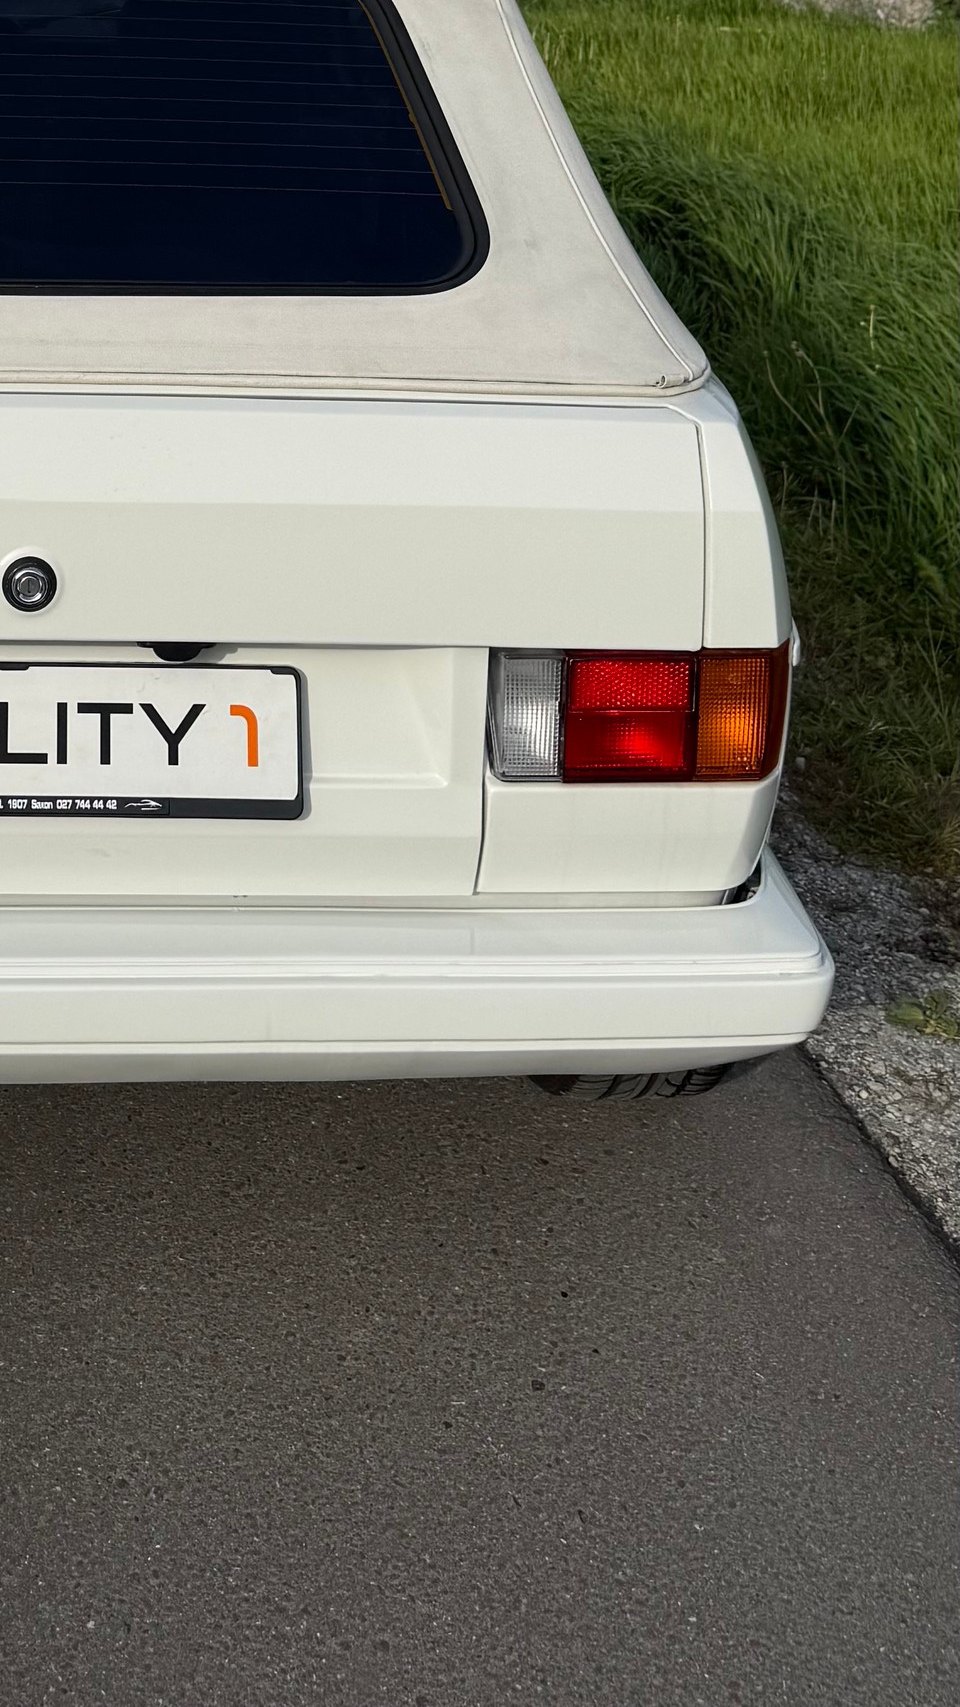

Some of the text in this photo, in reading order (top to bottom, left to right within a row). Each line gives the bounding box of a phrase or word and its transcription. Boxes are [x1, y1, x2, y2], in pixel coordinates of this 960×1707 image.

[31, 798, 54, 810] Saxon
[56, 799, 73, 810] 027
[74, 799, 91, 810] 744
[92, 799, 104, 810] 44
[106, 799, 118, 810] 42
